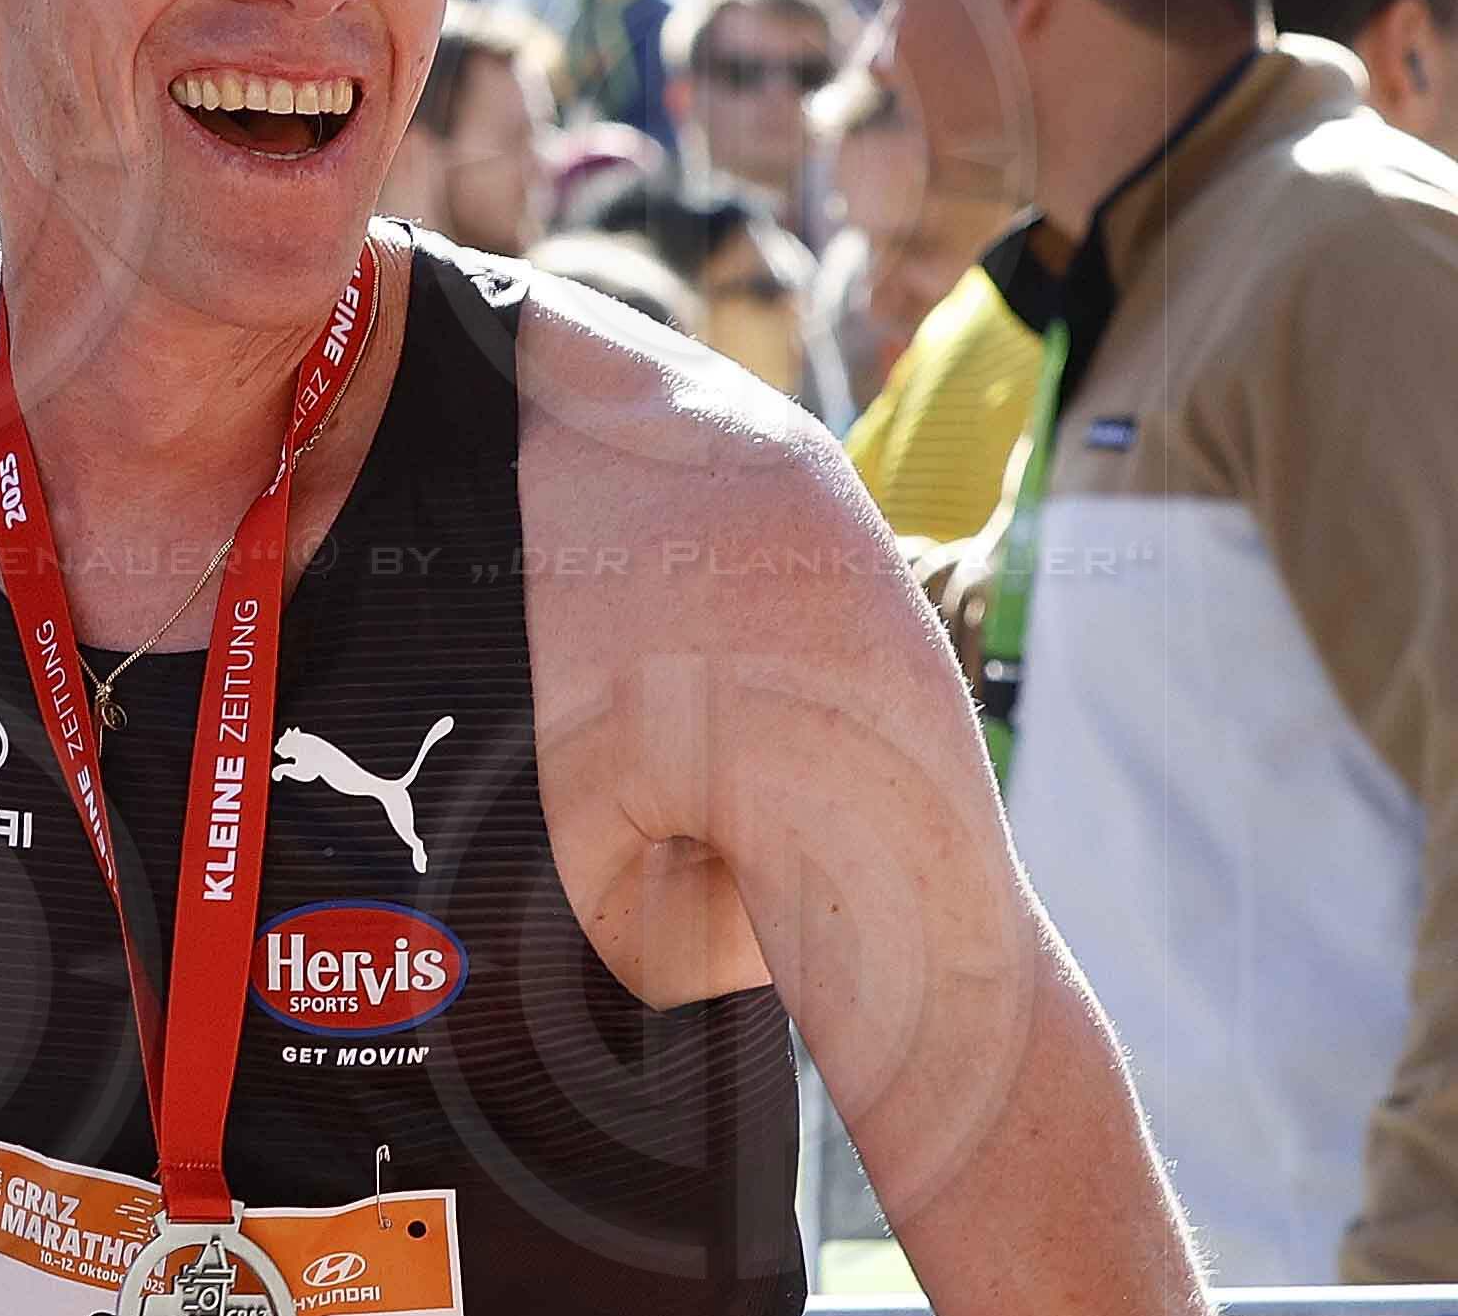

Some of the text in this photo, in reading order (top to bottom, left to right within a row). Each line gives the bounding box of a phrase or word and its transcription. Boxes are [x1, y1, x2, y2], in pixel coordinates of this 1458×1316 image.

[0, 453, 27, 530] 2025
[36, 619, 84, 760] ZEITUNG
[203, 597, 259, 902] KLEINE ZEITUNG
[266, 932, 447, 1006] Hervis
[289, 996, 359, 1014] SPORTS
[282, 1046, 327, 1066] GET
[7, 1177, 80, 1226] GRAZ
[293, 1285, 382, 1312] HYUNDAI
